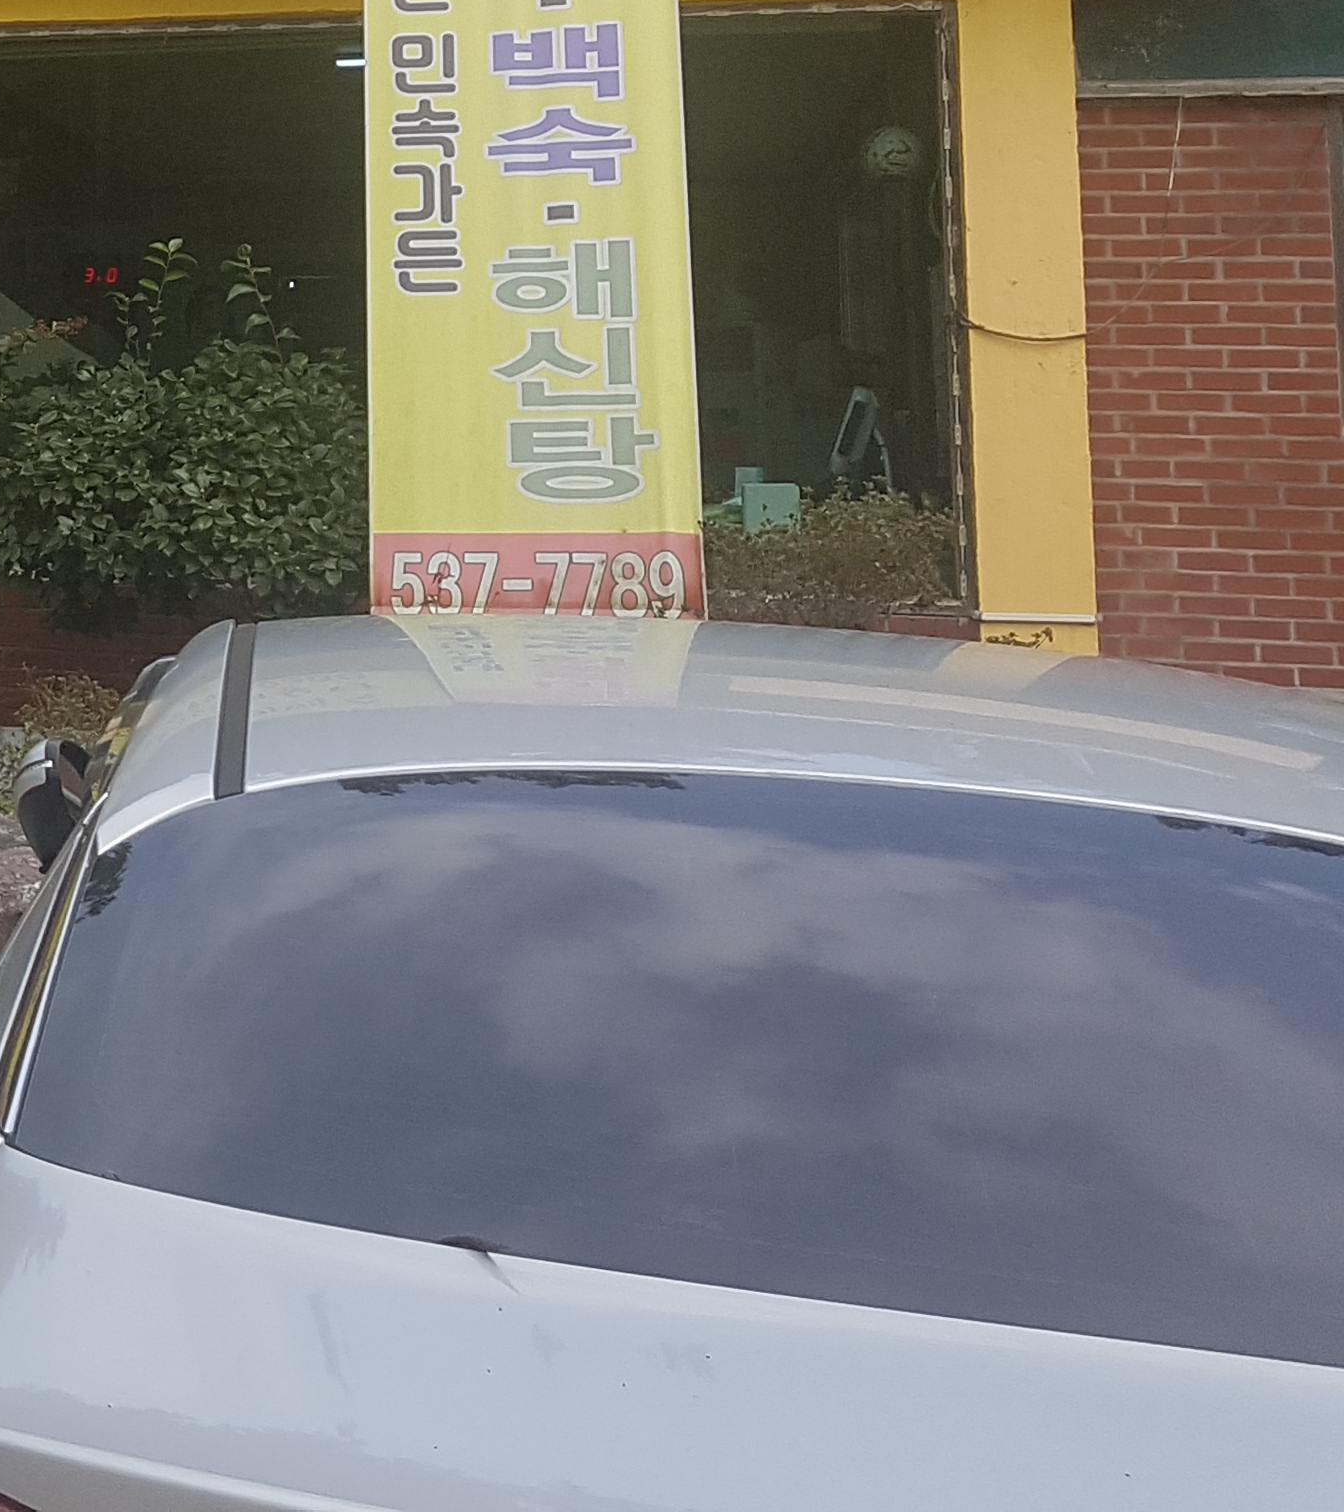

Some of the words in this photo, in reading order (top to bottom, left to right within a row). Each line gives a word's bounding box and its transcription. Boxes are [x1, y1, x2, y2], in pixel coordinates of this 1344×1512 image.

[389, 31, 465, 295] 민속가든
[485, 21, 636, 185] 백숙
[488, 236, 659, 504] 해신탕
[390, 550, 686, 621] 537-7789
